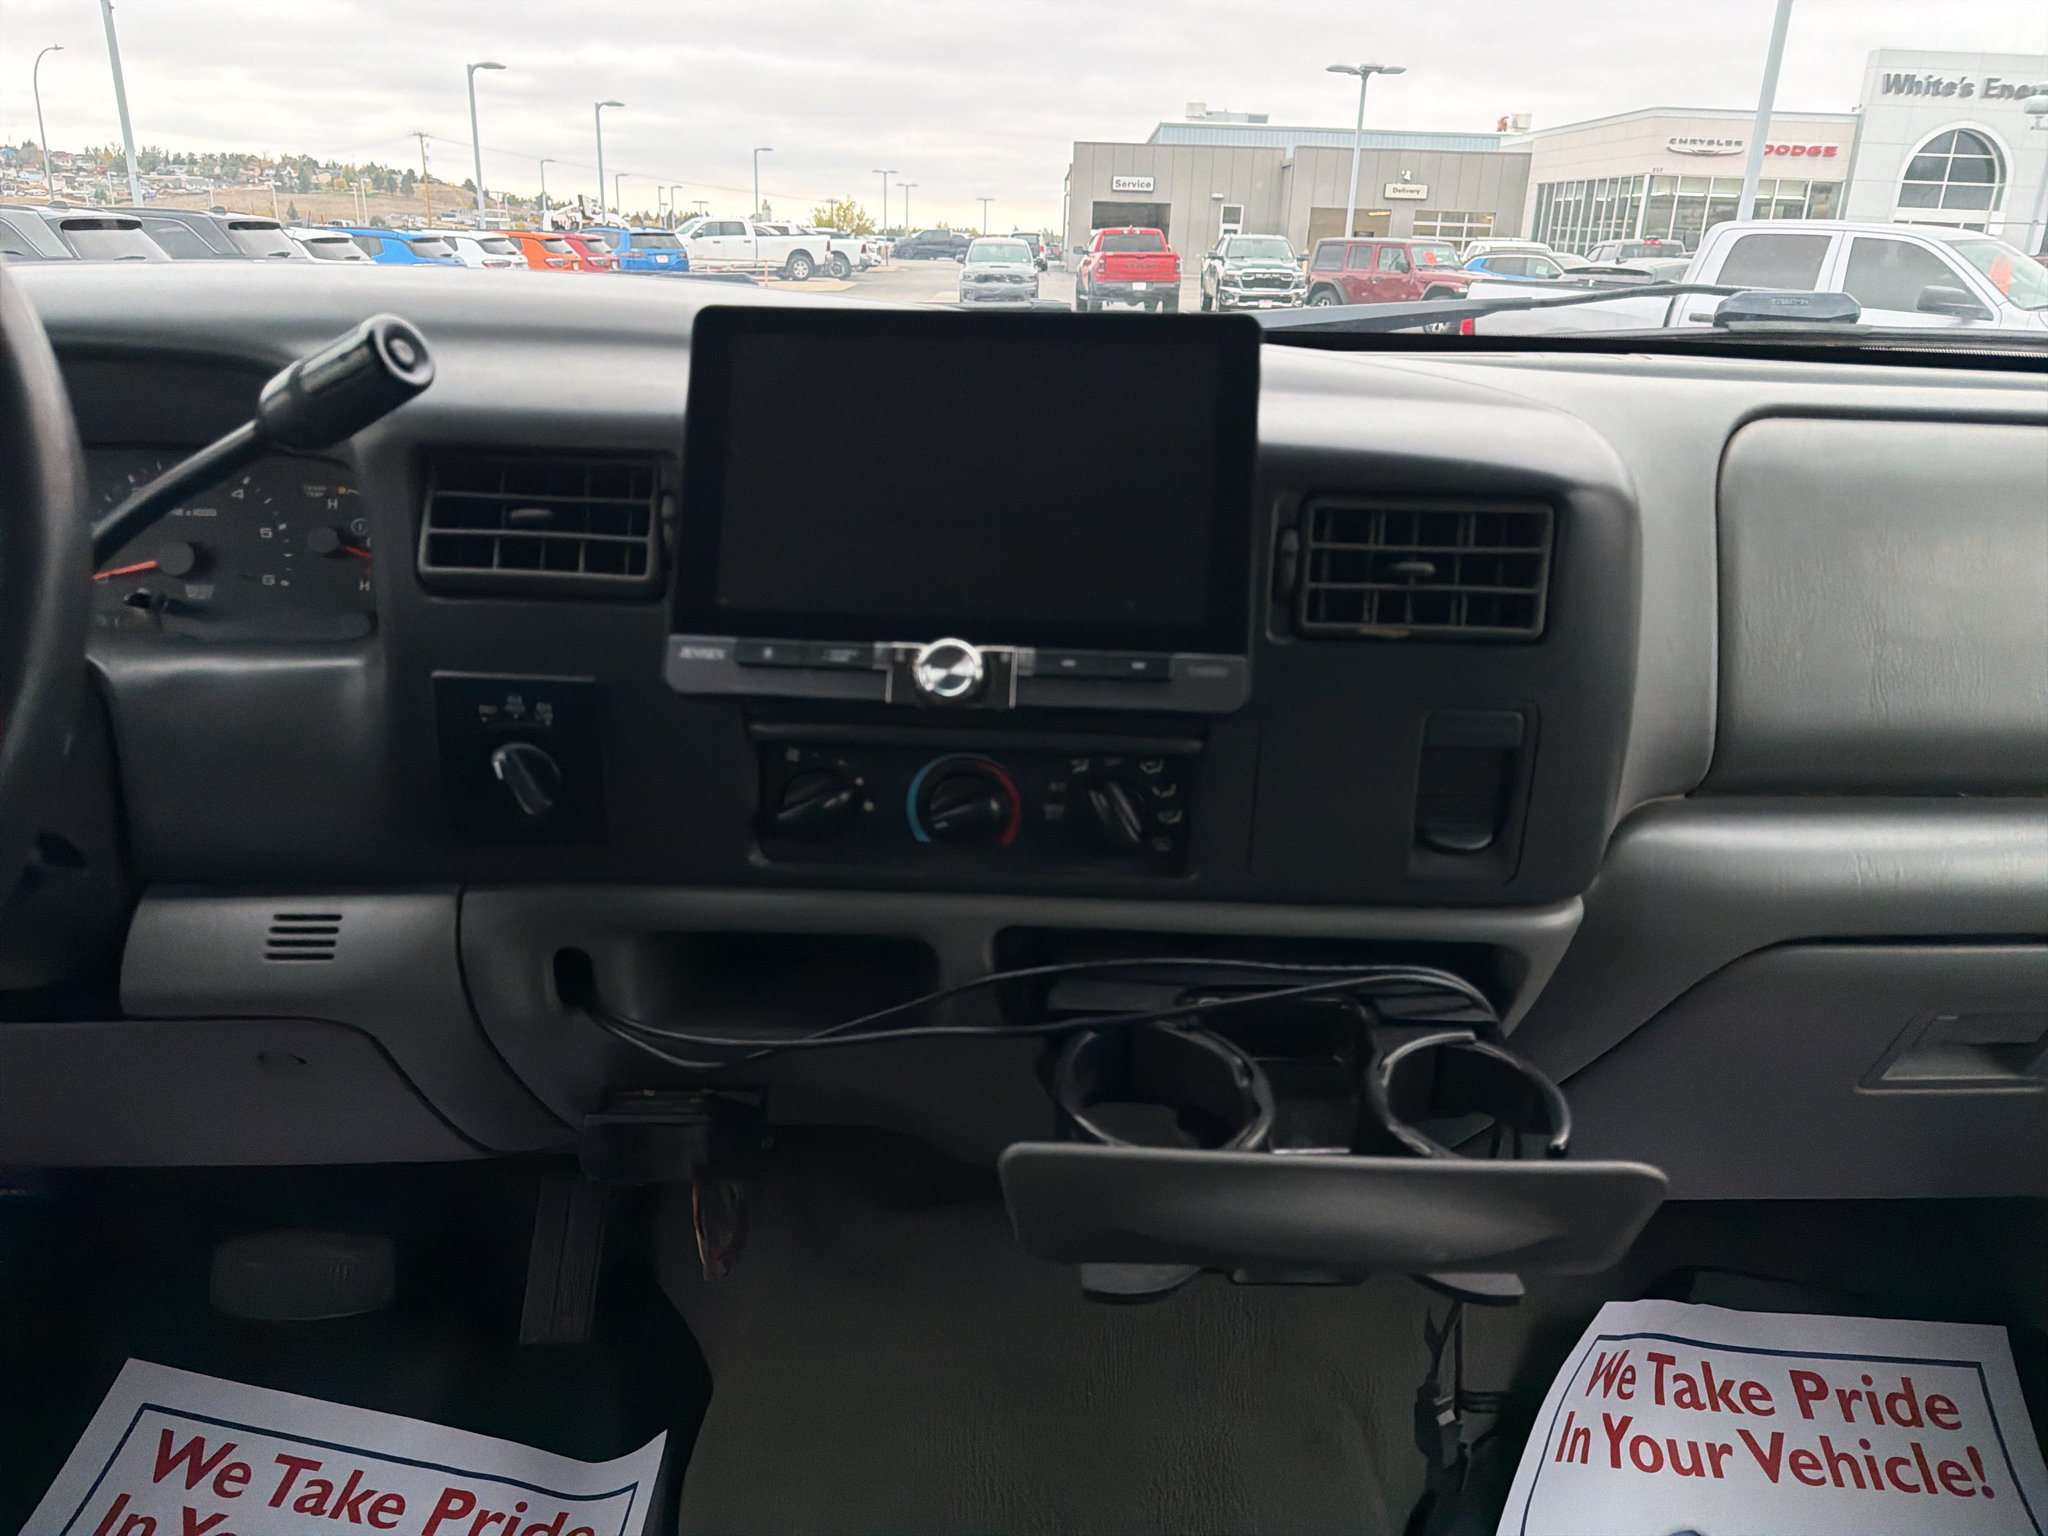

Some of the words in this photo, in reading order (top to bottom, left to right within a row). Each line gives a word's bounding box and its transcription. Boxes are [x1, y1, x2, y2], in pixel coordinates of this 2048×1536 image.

[1883, 73, 1975, 98] White's
[1669, 137, 1743, 147] CHRYSLER
[1115, 179, 1152, 188] Service
[1392, 187, 1421, 195] Delivery
[231, 489, 245, 499] 4
[327, 498, 339, 510] H
[260, 527, 273, 538] 5
[360, 580, 370, 591] H
[1586, 1350, 1637, 1399] We
[1648, 1352, 1775, 1417] Take
[1789, 1370, 1962, 1430] Pride
[1555, 1411, 1591, 1464] In
[1603, 1413, 1733, 1479] Your
[1737, 1429, 1996, 1499] Vehicle!
[153, 1428, 251, 1498] We
[266, 1454, 406, 1529] Take
[93, 1493, 158, 1536] In
